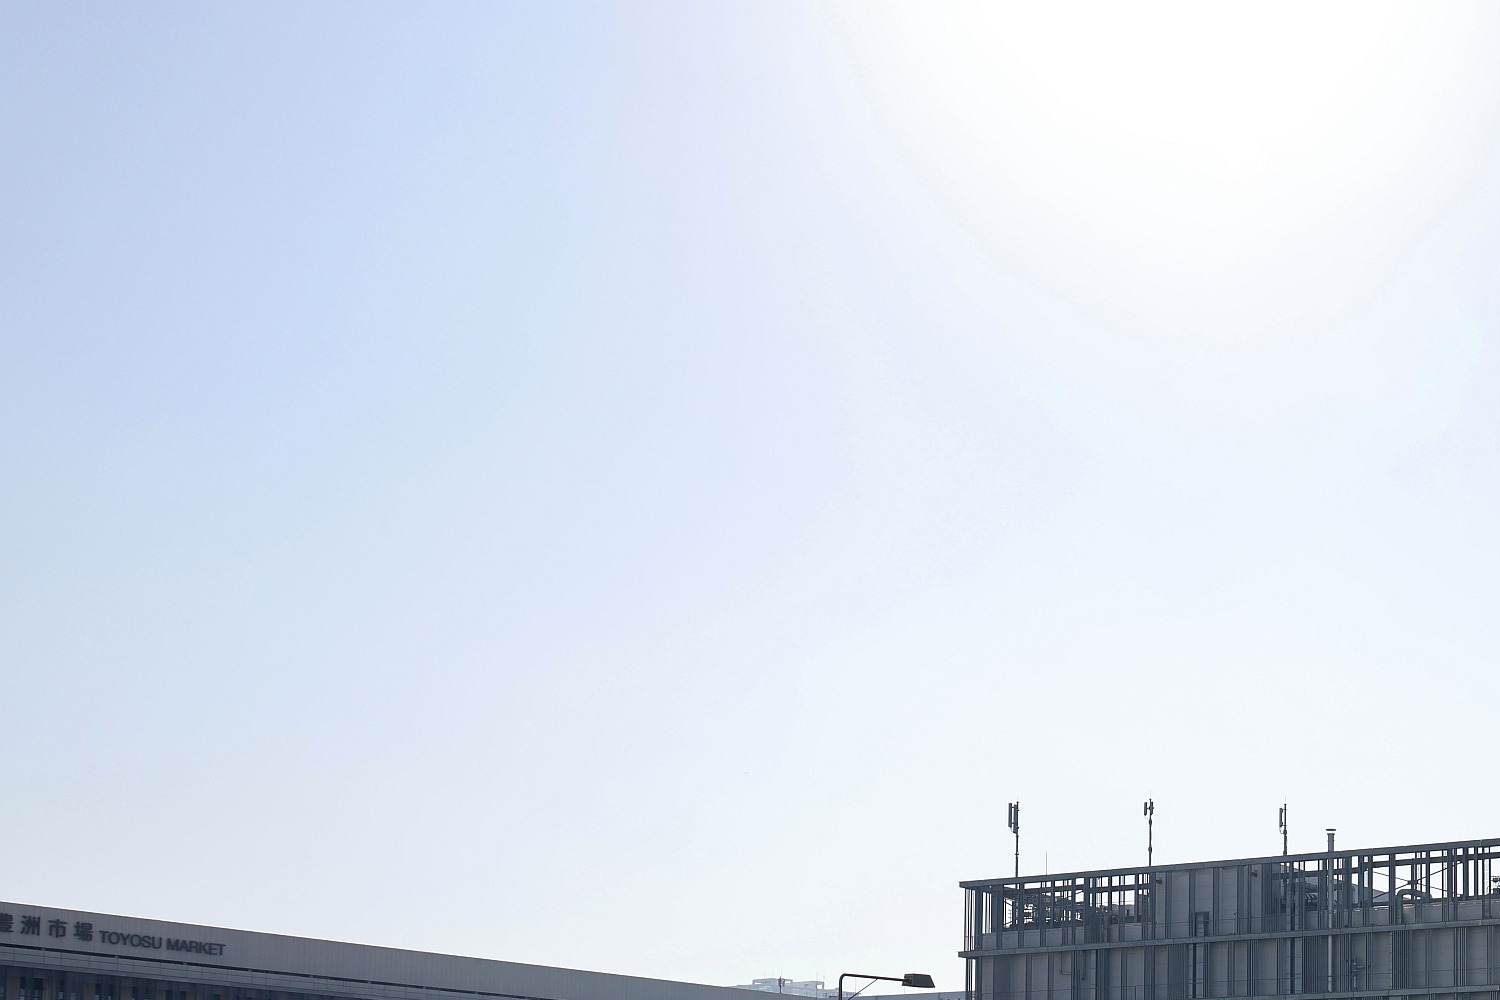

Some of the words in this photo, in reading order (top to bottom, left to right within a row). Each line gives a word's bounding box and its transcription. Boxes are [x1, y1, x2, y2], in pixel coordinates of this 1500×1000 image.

[0, 912, 94, 942] 豊洲市場
[99, 930, 163, 950] TOYOSU
[166, 938, 226, 956] MARKET
